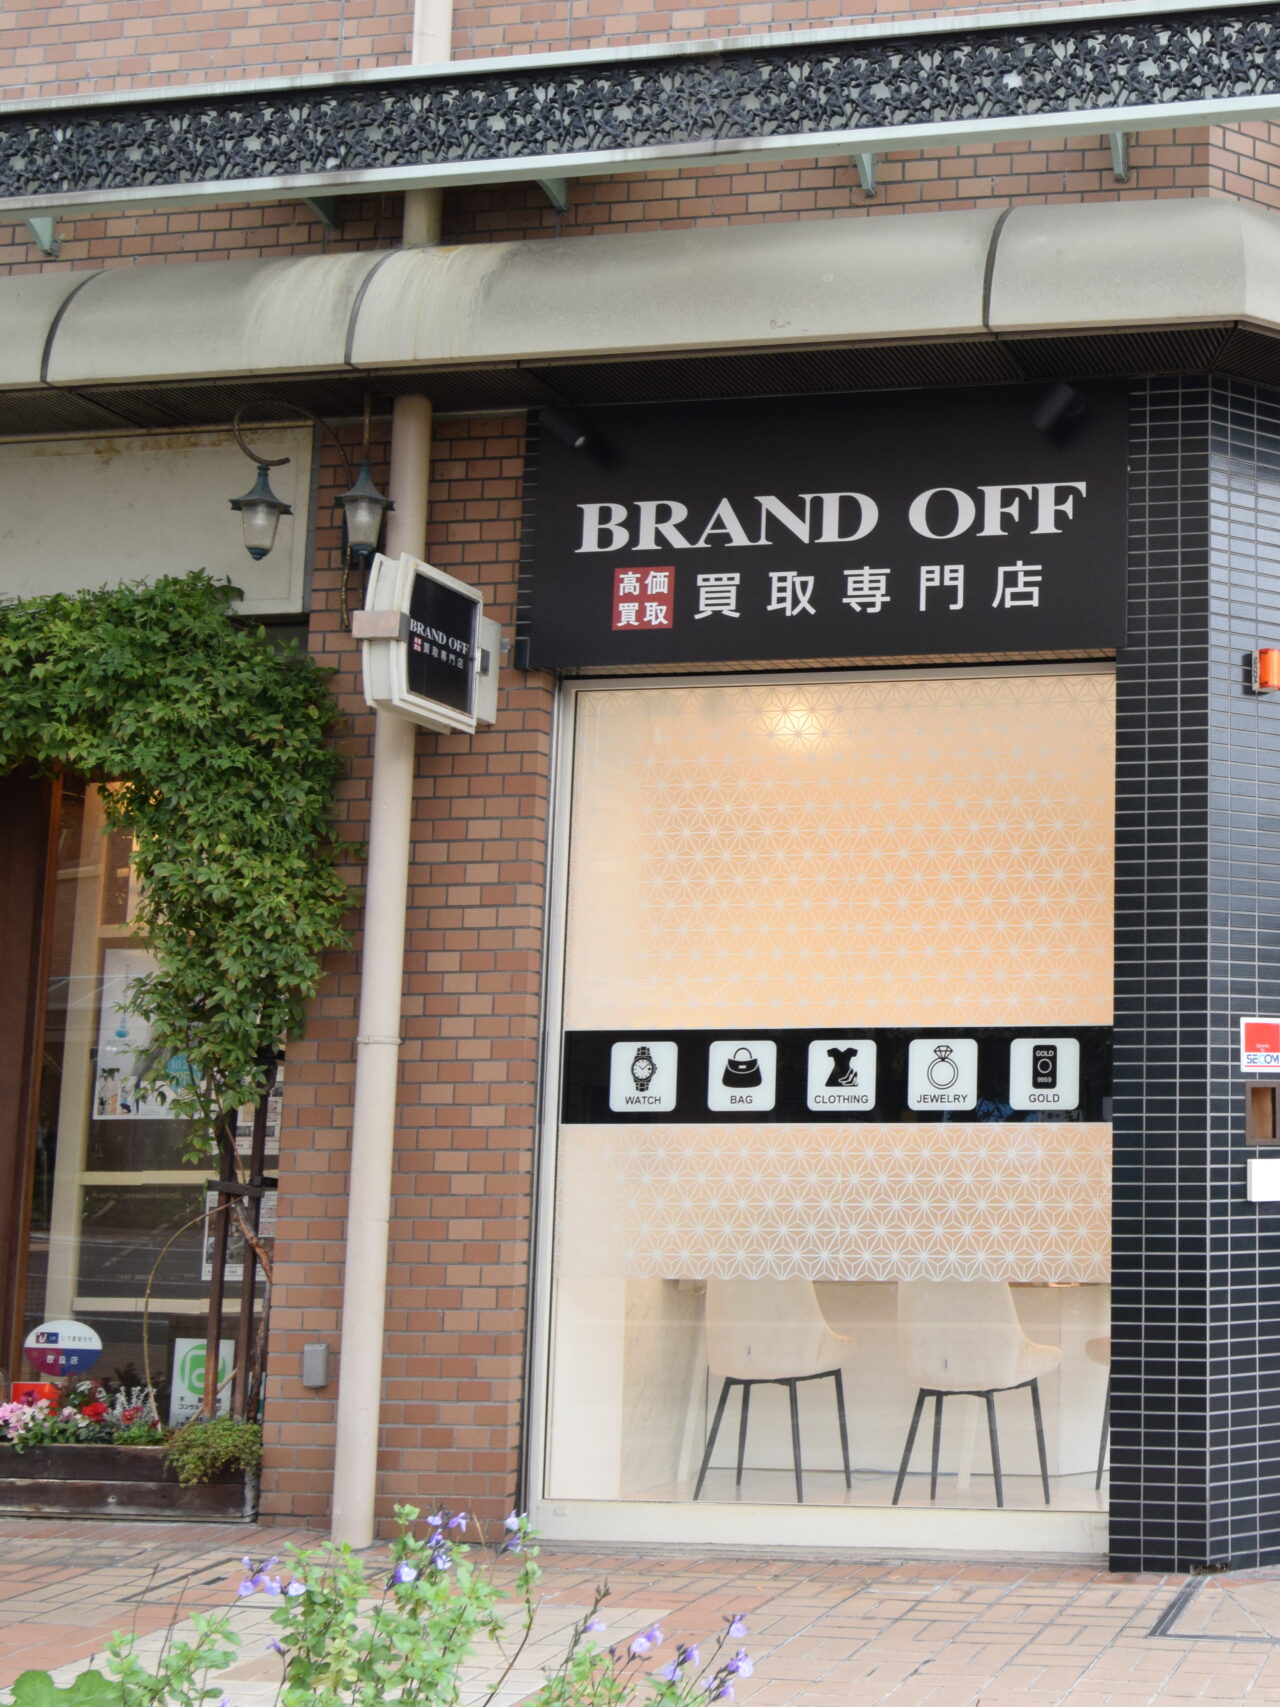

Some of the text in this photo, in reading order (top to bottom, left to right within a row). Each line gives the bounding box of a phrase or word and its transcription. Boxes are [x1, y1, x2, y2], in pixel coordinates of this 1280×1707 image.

[574, 481, 1087, 553] BRAND OFF
[619, 571, 670, 596] 高価
[693, 560, 1043, 620] 買取専門店
[617, 601, 669, 627] 買取
[409, 618, 447, 645] BRAND
[448, 637, 470, 655] OFF
[1246, 1053, 1279, 1064] SECOM
[624, 1095, 662, 1105] WATCH
[730, 1095, 753, 1104] BAG
[814, 1094, 869, 1104] CLOTHING
[917, 1094, 968, 1104] JEWELRY
[1028, 1093, 1060, 1103] GOLD
